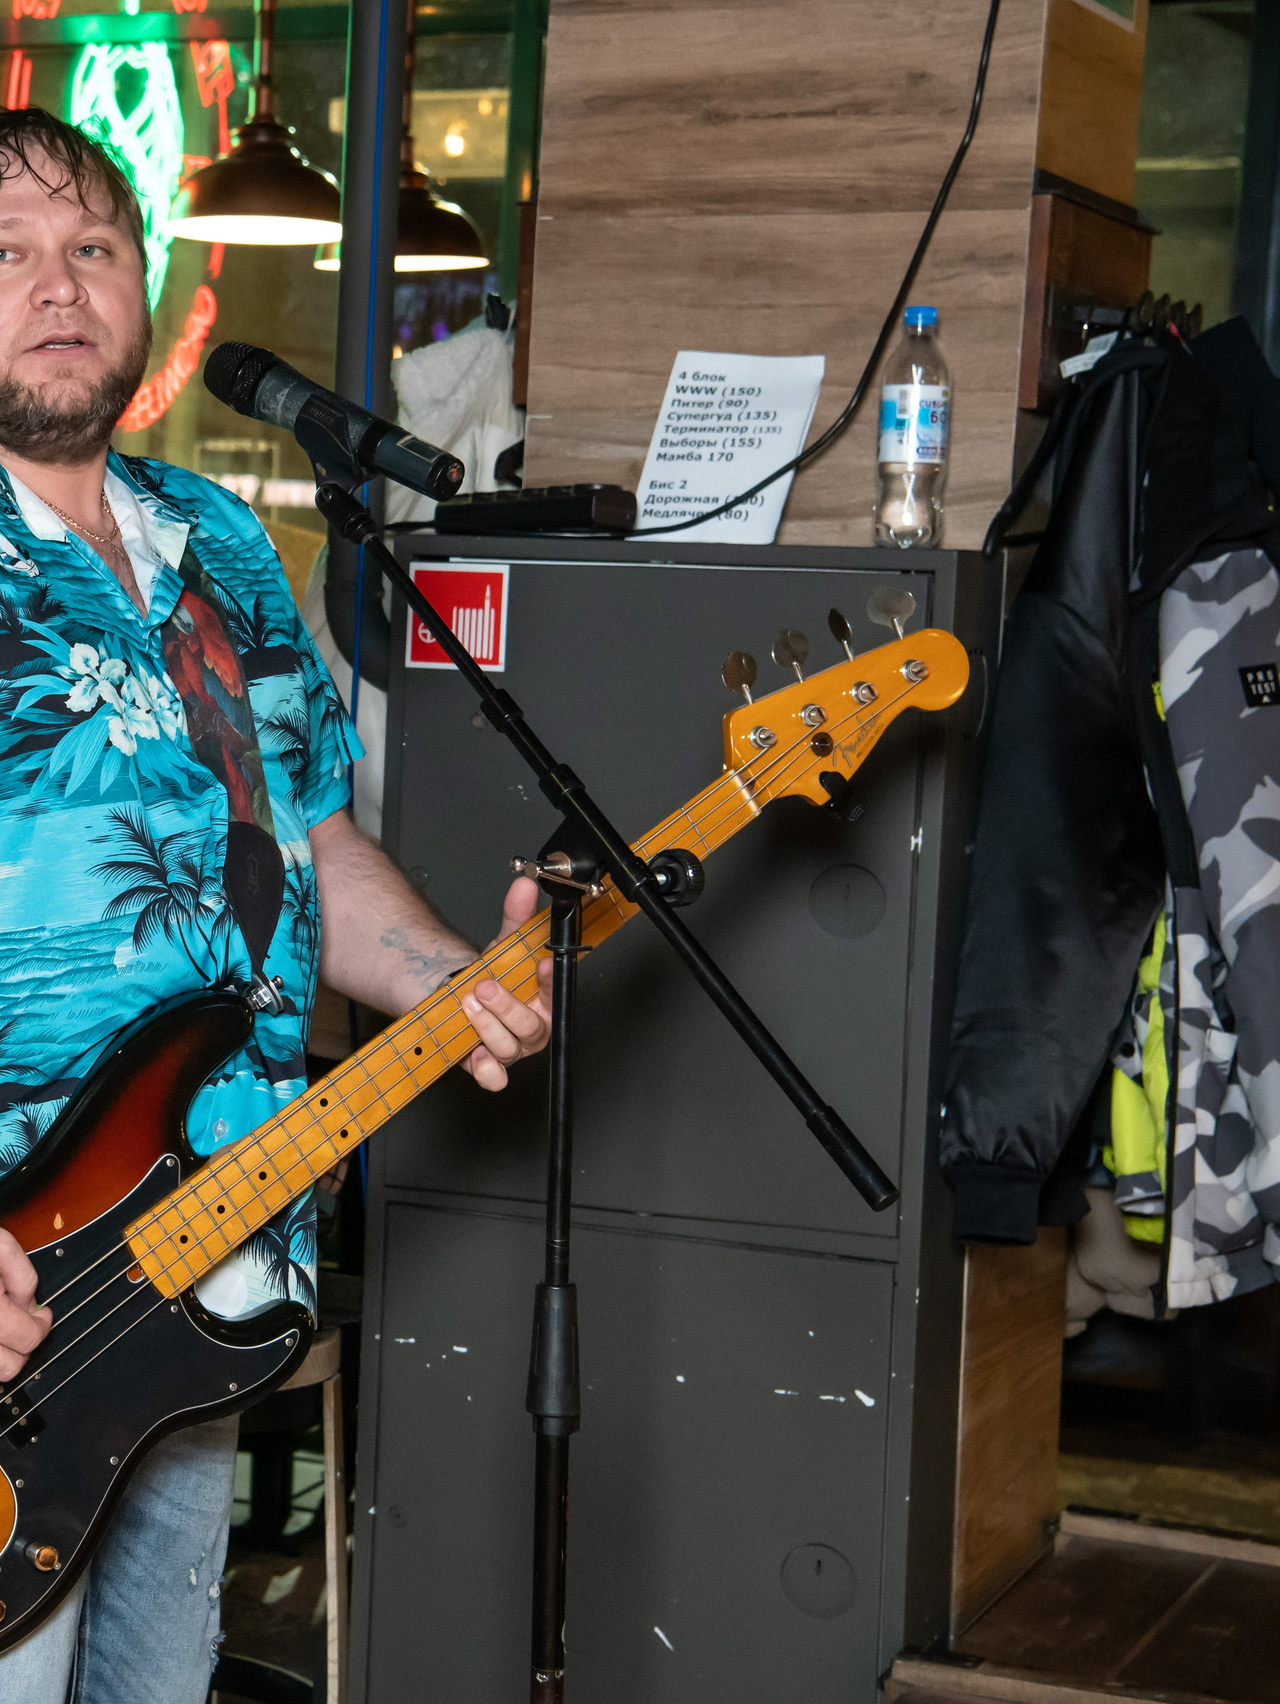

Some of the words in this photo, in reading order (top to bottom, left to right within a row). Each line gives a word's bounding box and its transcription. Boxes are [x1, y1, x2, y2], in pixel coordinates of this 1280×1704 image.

[678, 371, 687, 380] 4
[692, 371, 726, 382] блок
[675, 385, 718, 396] WWW
[721, 387, 762, 398] (150)
[670, 399, 714, 409] Питер
[718, 400, 749, 410] (90)
[667, 412, 733, 422] Супергуд
[737, 411, 777, 422] (135)
[664, 424, 748, 435] Терминатор
[660, 438, 717, 448] Выборы
[722, 438, 762, 449] (155)
[656, 452, 702, 462] Мамба
[708, 452, 734, 462] 170
[649, 480, 674, 490] Бис
[679, 480, 687, 490] 2
[644, 494, 720, 506] Дорожная
